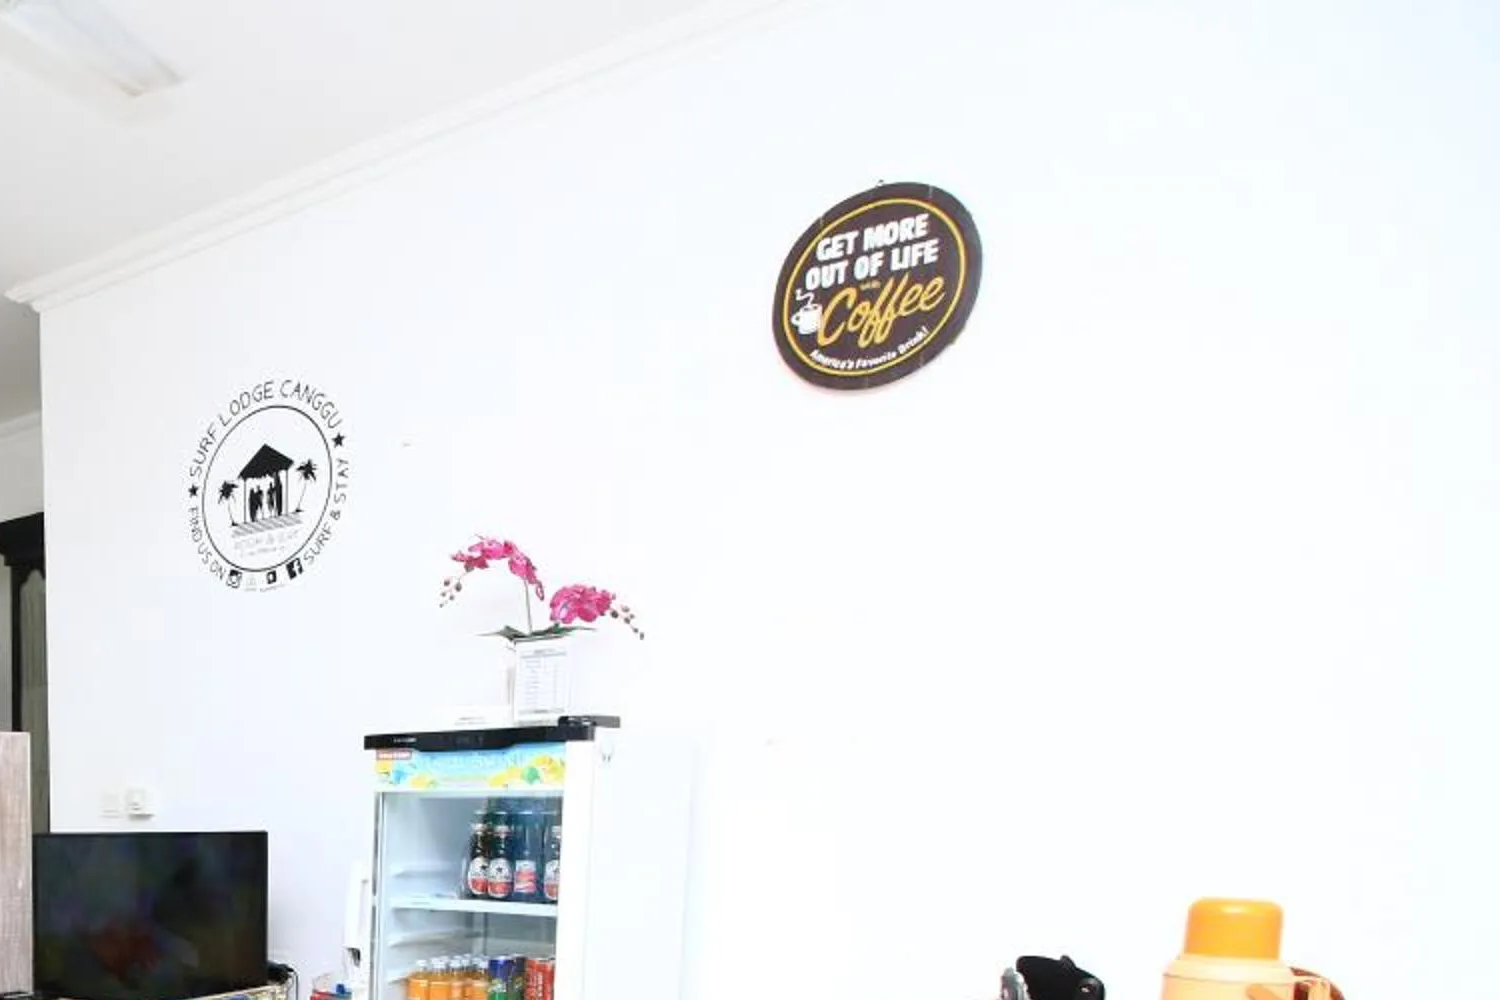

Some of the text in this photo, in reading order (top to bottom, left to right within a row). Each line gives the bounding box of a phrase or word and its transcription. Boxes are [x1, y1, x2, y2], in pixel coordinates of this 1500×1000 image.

[805, 260, 849, 291] OUT
[853, 251, 884, 281] OF
[890, 238, 939, 271] LIFE
[816, 213, 929, 261] GET MORE
[817, 271, 946, 348] Coffee
[190, 379, 343, 478] SURF LODGE CANGGU
[303, 520, 332, 566] SURF
[333, 458, 349, 505] STAY
